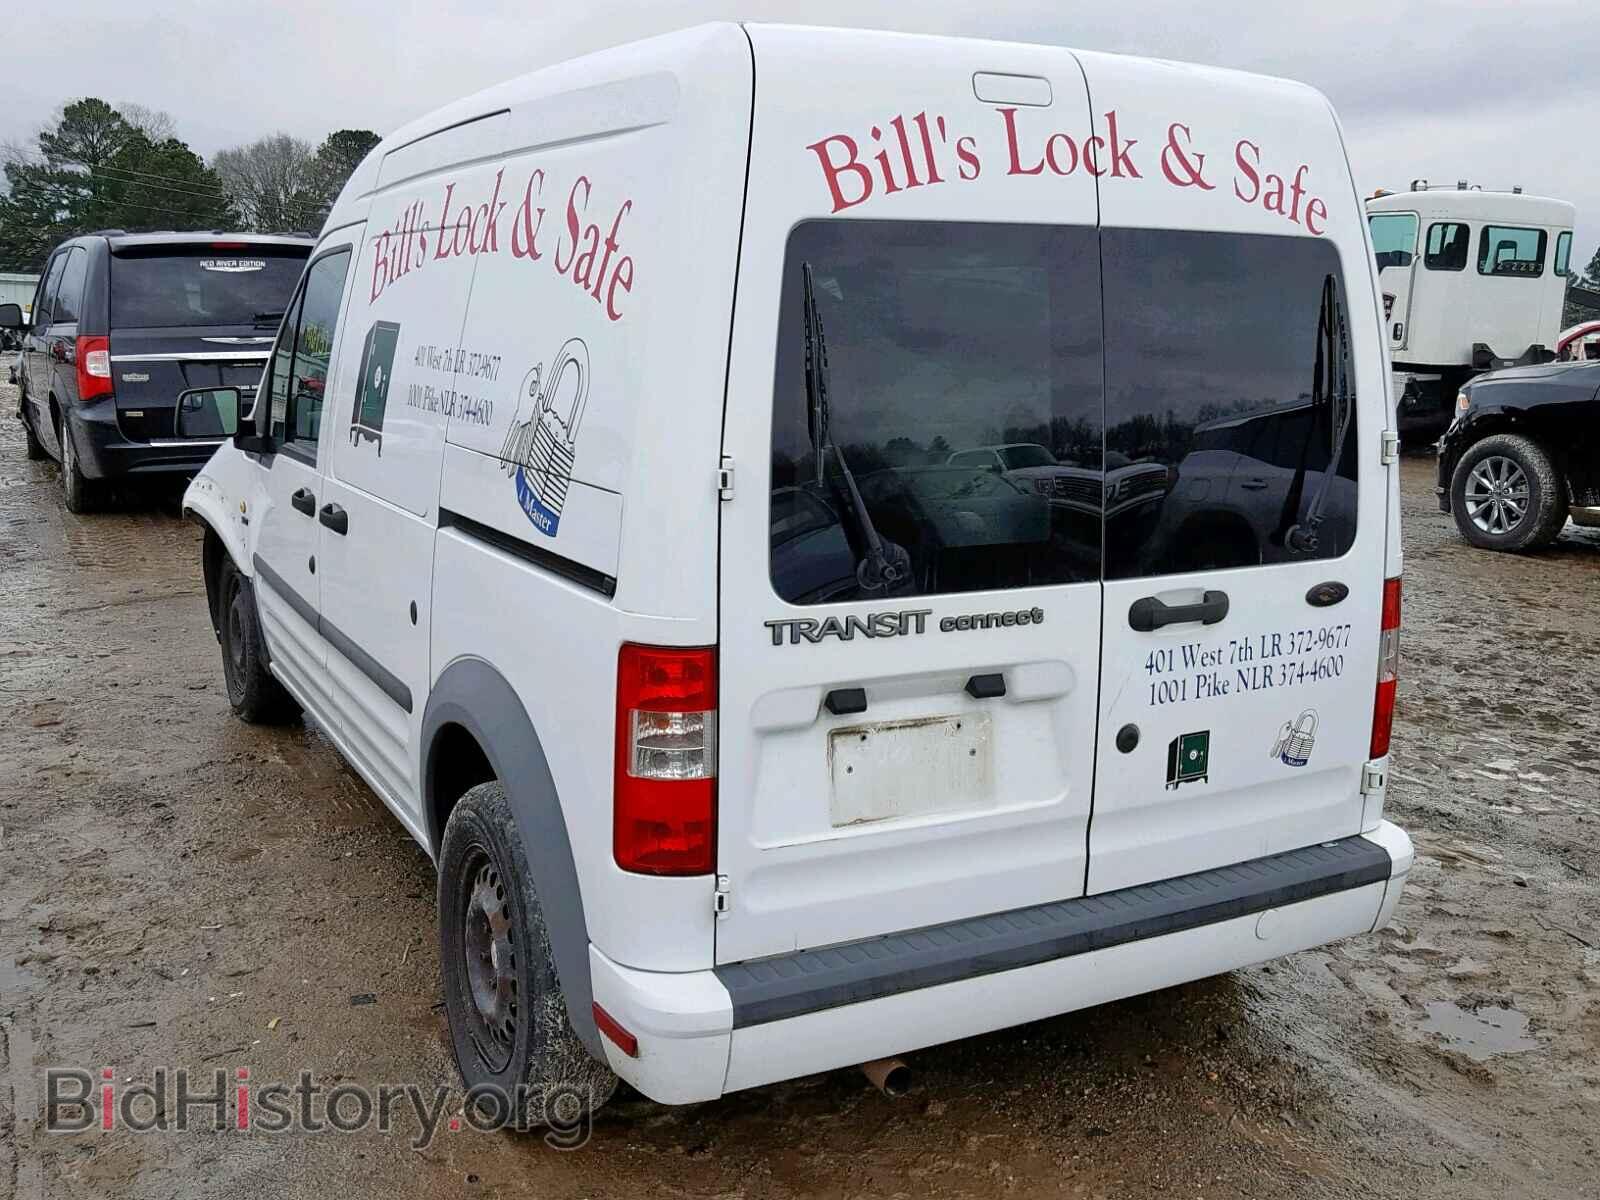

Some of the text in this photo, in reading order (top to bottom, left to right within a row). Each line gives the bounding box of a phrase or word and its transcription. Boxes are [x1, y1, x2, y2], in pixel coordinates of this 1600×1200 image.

[806, 107, 1328, 235] Bill's Lock & Safe
[369, 166, 634, 321] Bill's Lock & Safe
[764, 607, 1045, 645] TRANSIT connect
[1144, 623, 1352, 676] 401 West 7th LR 372-9677
[1149, 653, 1345, 706] 1001 Pike NLR 374-4600
